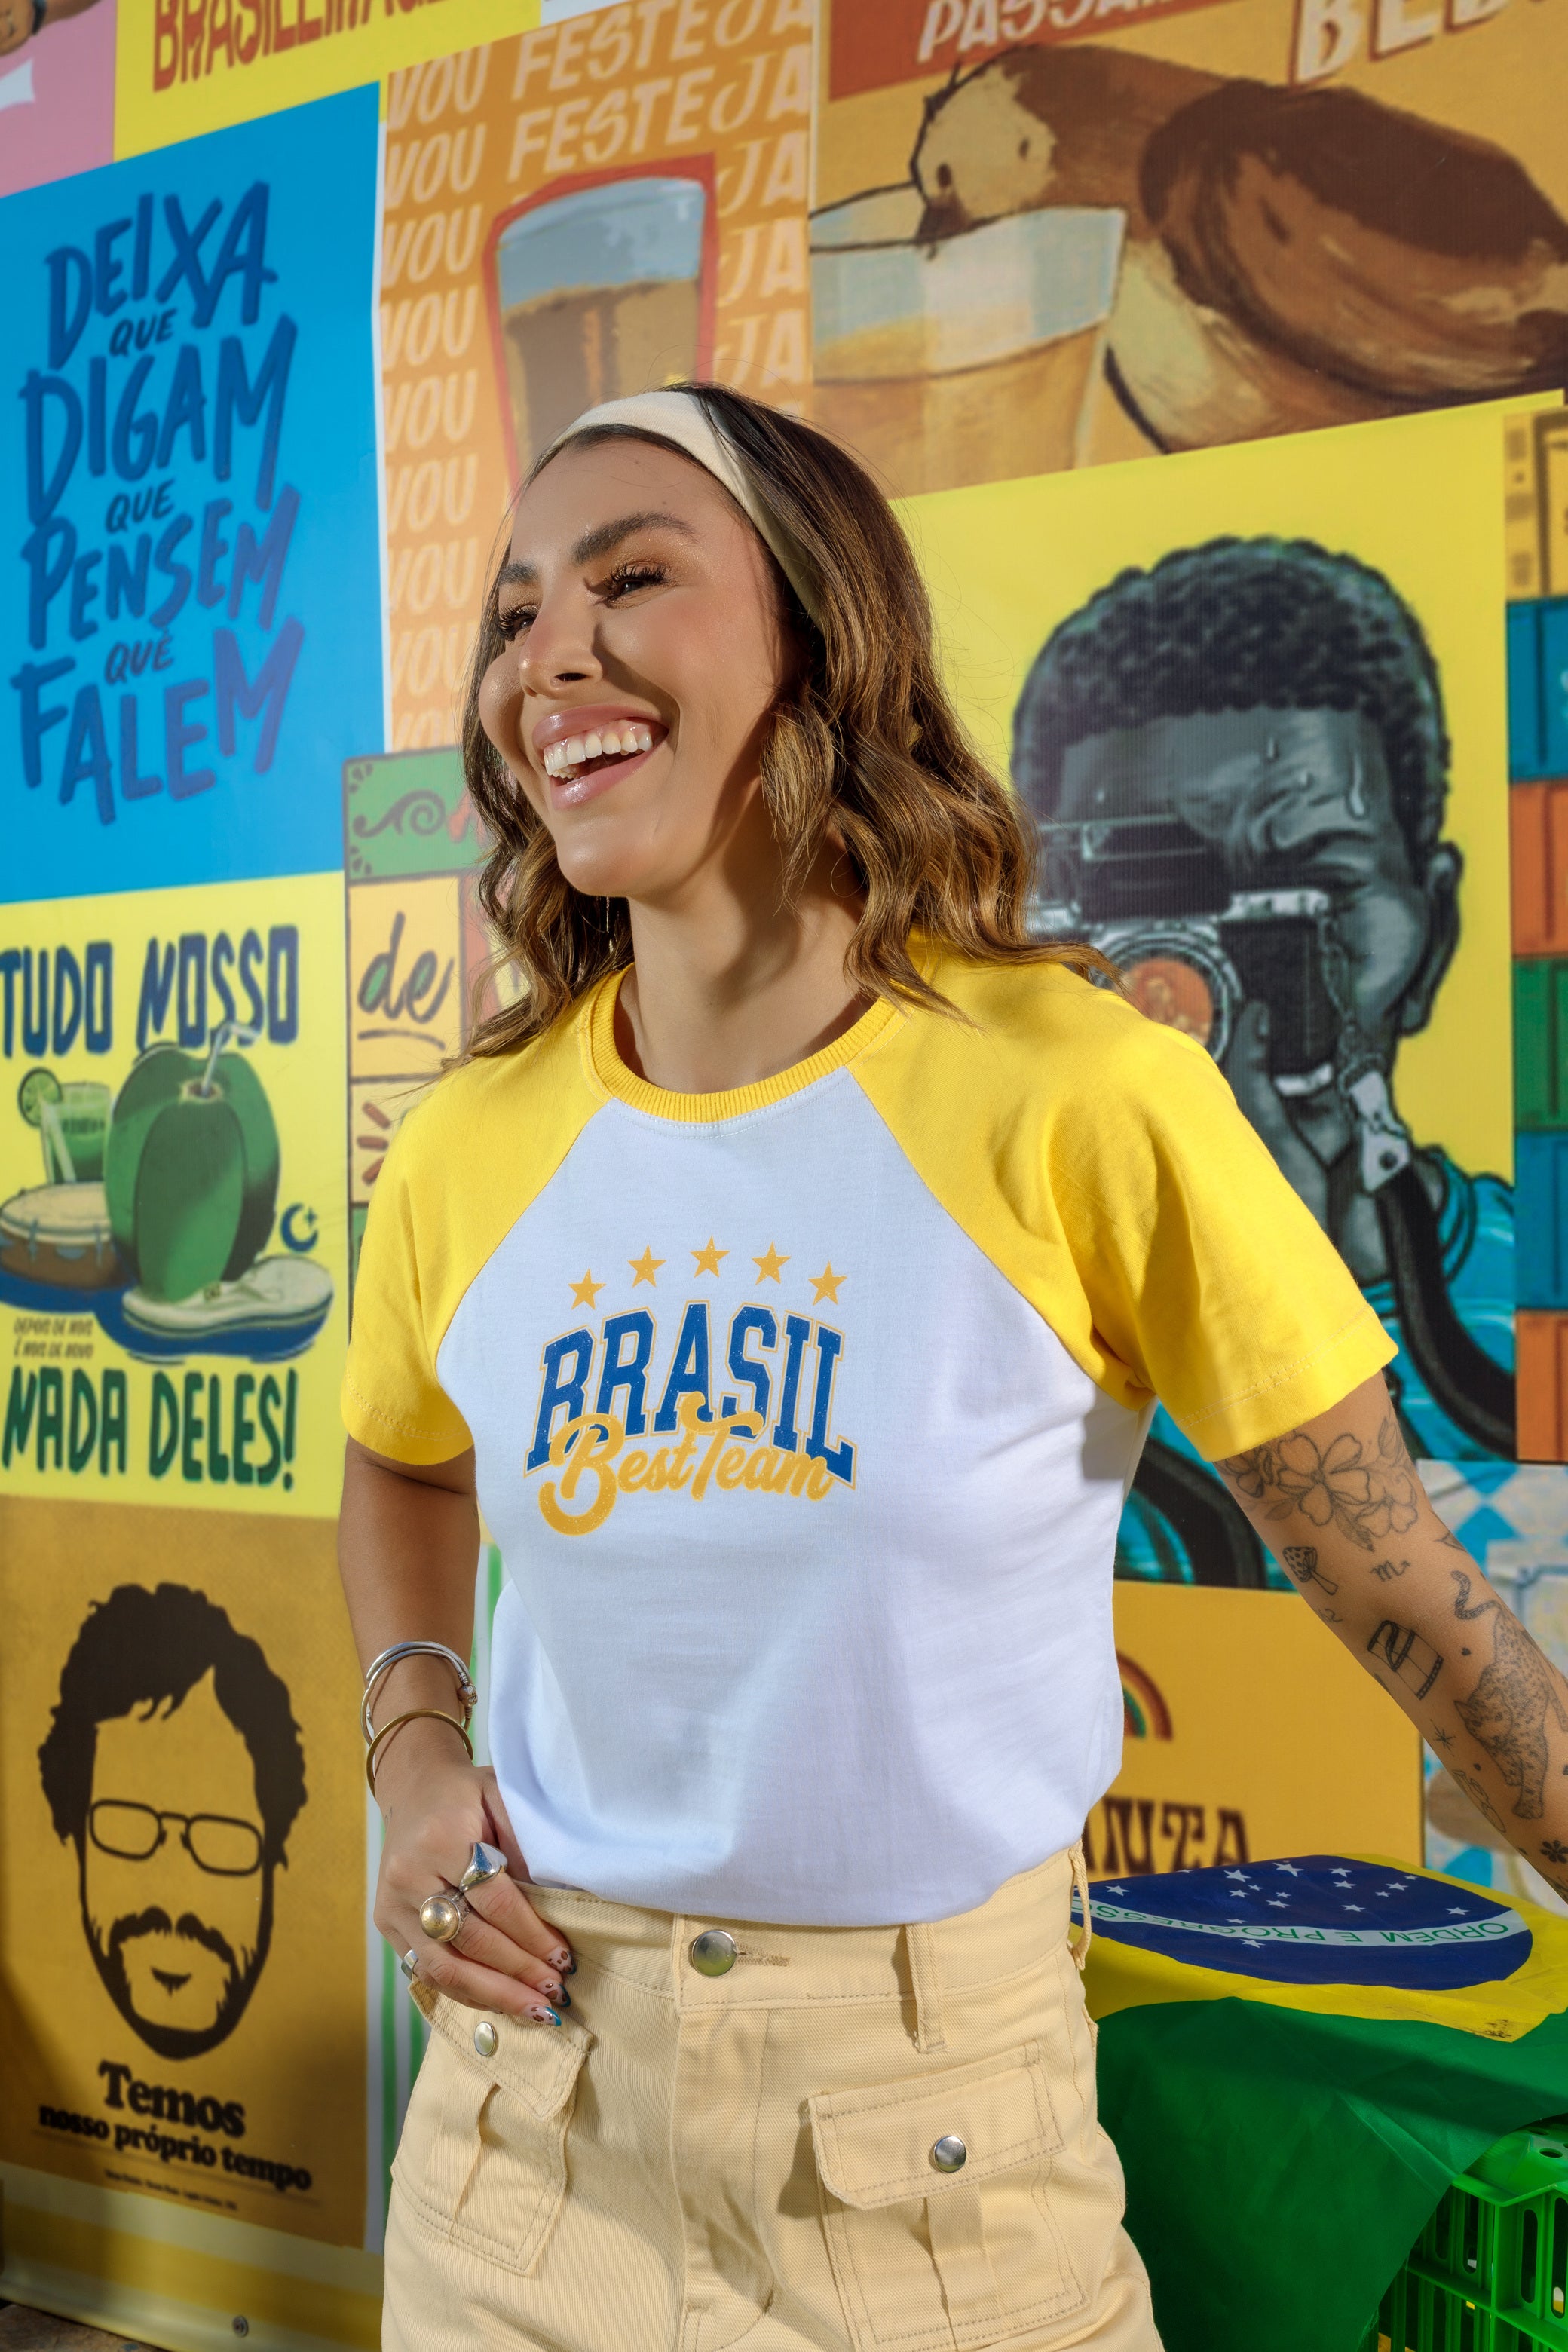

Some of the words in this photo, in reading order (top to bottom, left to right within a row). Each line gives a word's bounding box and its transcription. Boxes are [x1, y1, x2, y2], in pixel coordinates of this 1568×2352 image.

[385, 124, 486, 210] VOU
[507, 44, 811, 183] FESTEJA
[387, 45, 492, 130] VOU
[44, 180, 278, 370] DEIXA
[382, 204, 482, 289] VOU
[109, 308, 177, 357] QUE
[380, 285, 479, 371] VOU
[18, 311, 298, 528] DIGAM
[383, 369, 477, 451] VOU
[106, 479, 175, 533] QUE
[386, 454, 477, 535] VOU
[20, 483, 301, 650] PENSEM
[387, 537, 478, 615] VOU
[11, 616, 305, 825] FALEM
[0, 942, 112, 1057] TUDO
[136, 925, 299, 1049] NOSSO
[357, 911, 455, 1024] de
[2, 1367, 128, 1475] NADA
[152, 1369, 296, 1490] DELES!
[524, 1300, 858, 1490] BRASIL
[537, 1412, 697, 1536] Best
[680, 1391, 834, 1501] Team
[1083, 1796, 1250, 1876] NTA
[1334, 1931, 1363, 1943] E
[1380, 1922, 1508, 1943] ORDEM
[98, 2059, 246, 2138] Temos
[38, 2104, 109, 2140] nosso
[115, 2124, 216, 2164] próprio
[222, 2147, 312, 2192] tempo
